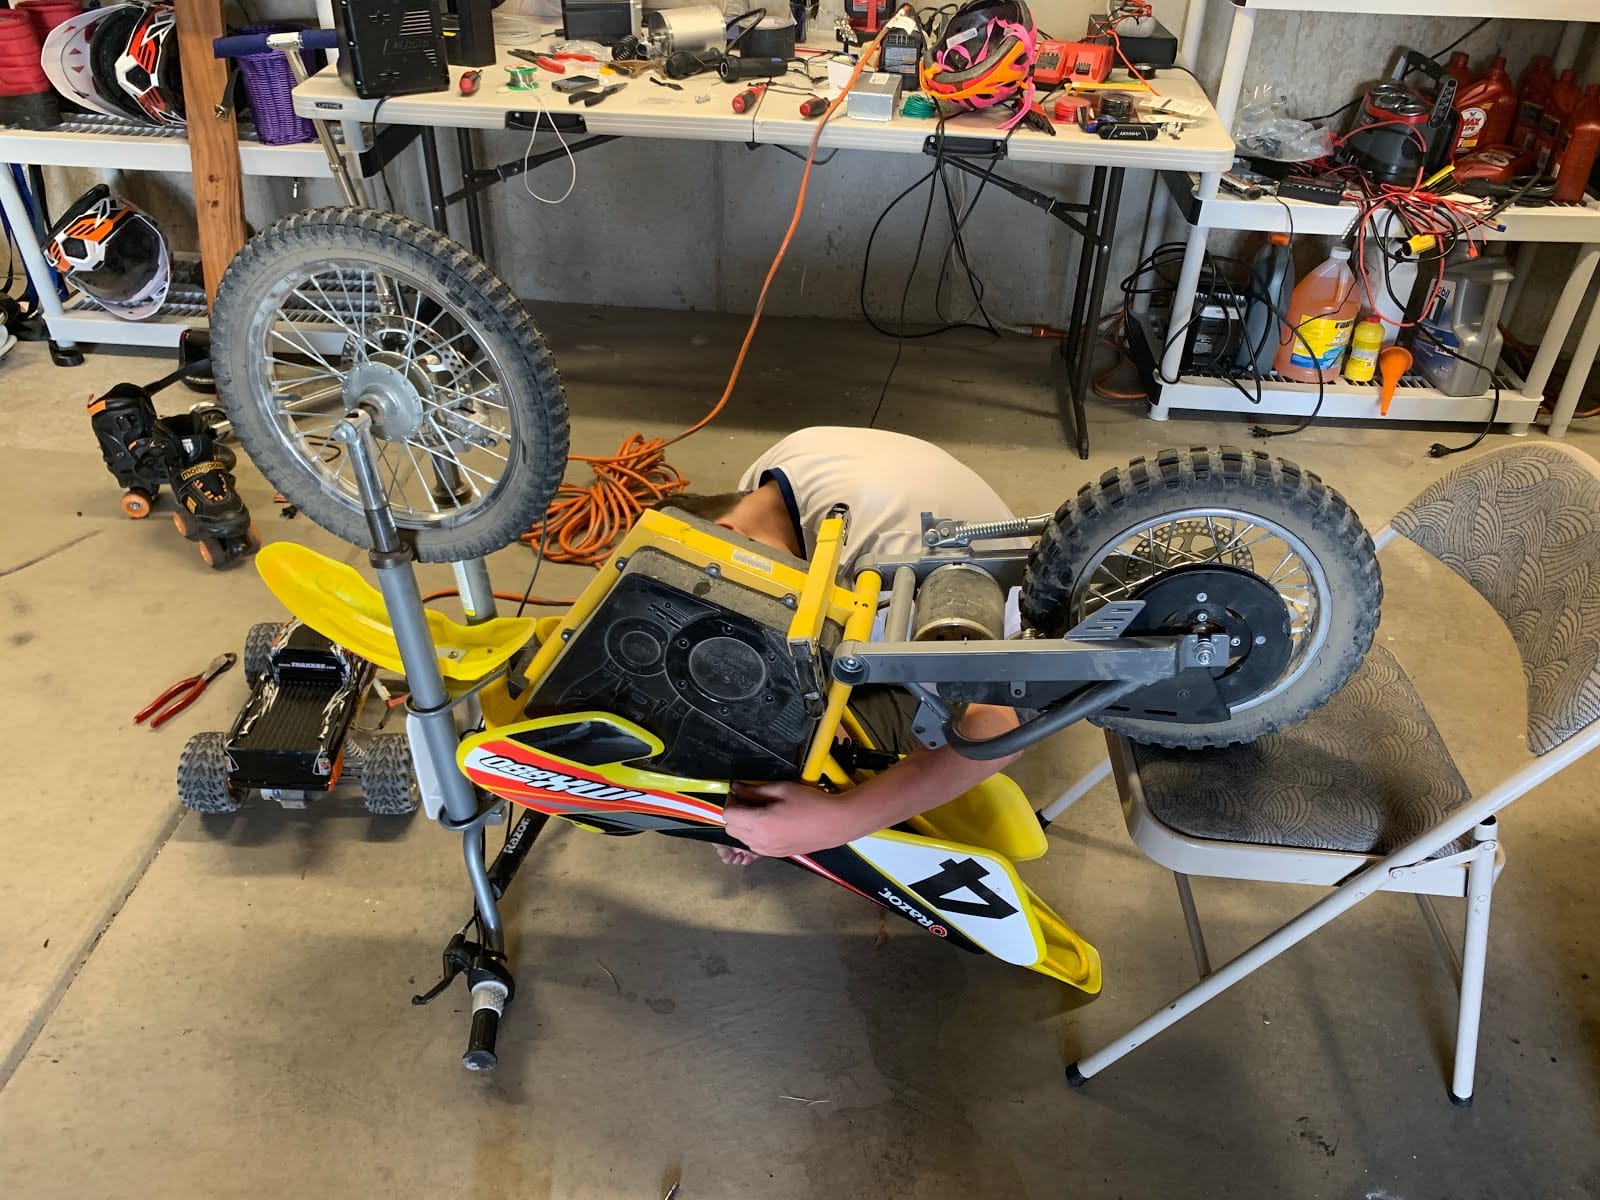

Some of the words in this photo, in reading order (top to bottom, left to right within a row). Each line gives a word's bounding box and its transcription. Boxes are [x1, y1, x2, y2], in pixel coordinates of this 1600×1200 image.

[479, 754, 647, 801] MX650
[503, 817, 531, 854] Razor
[907, 857, 1020, 920] 4
